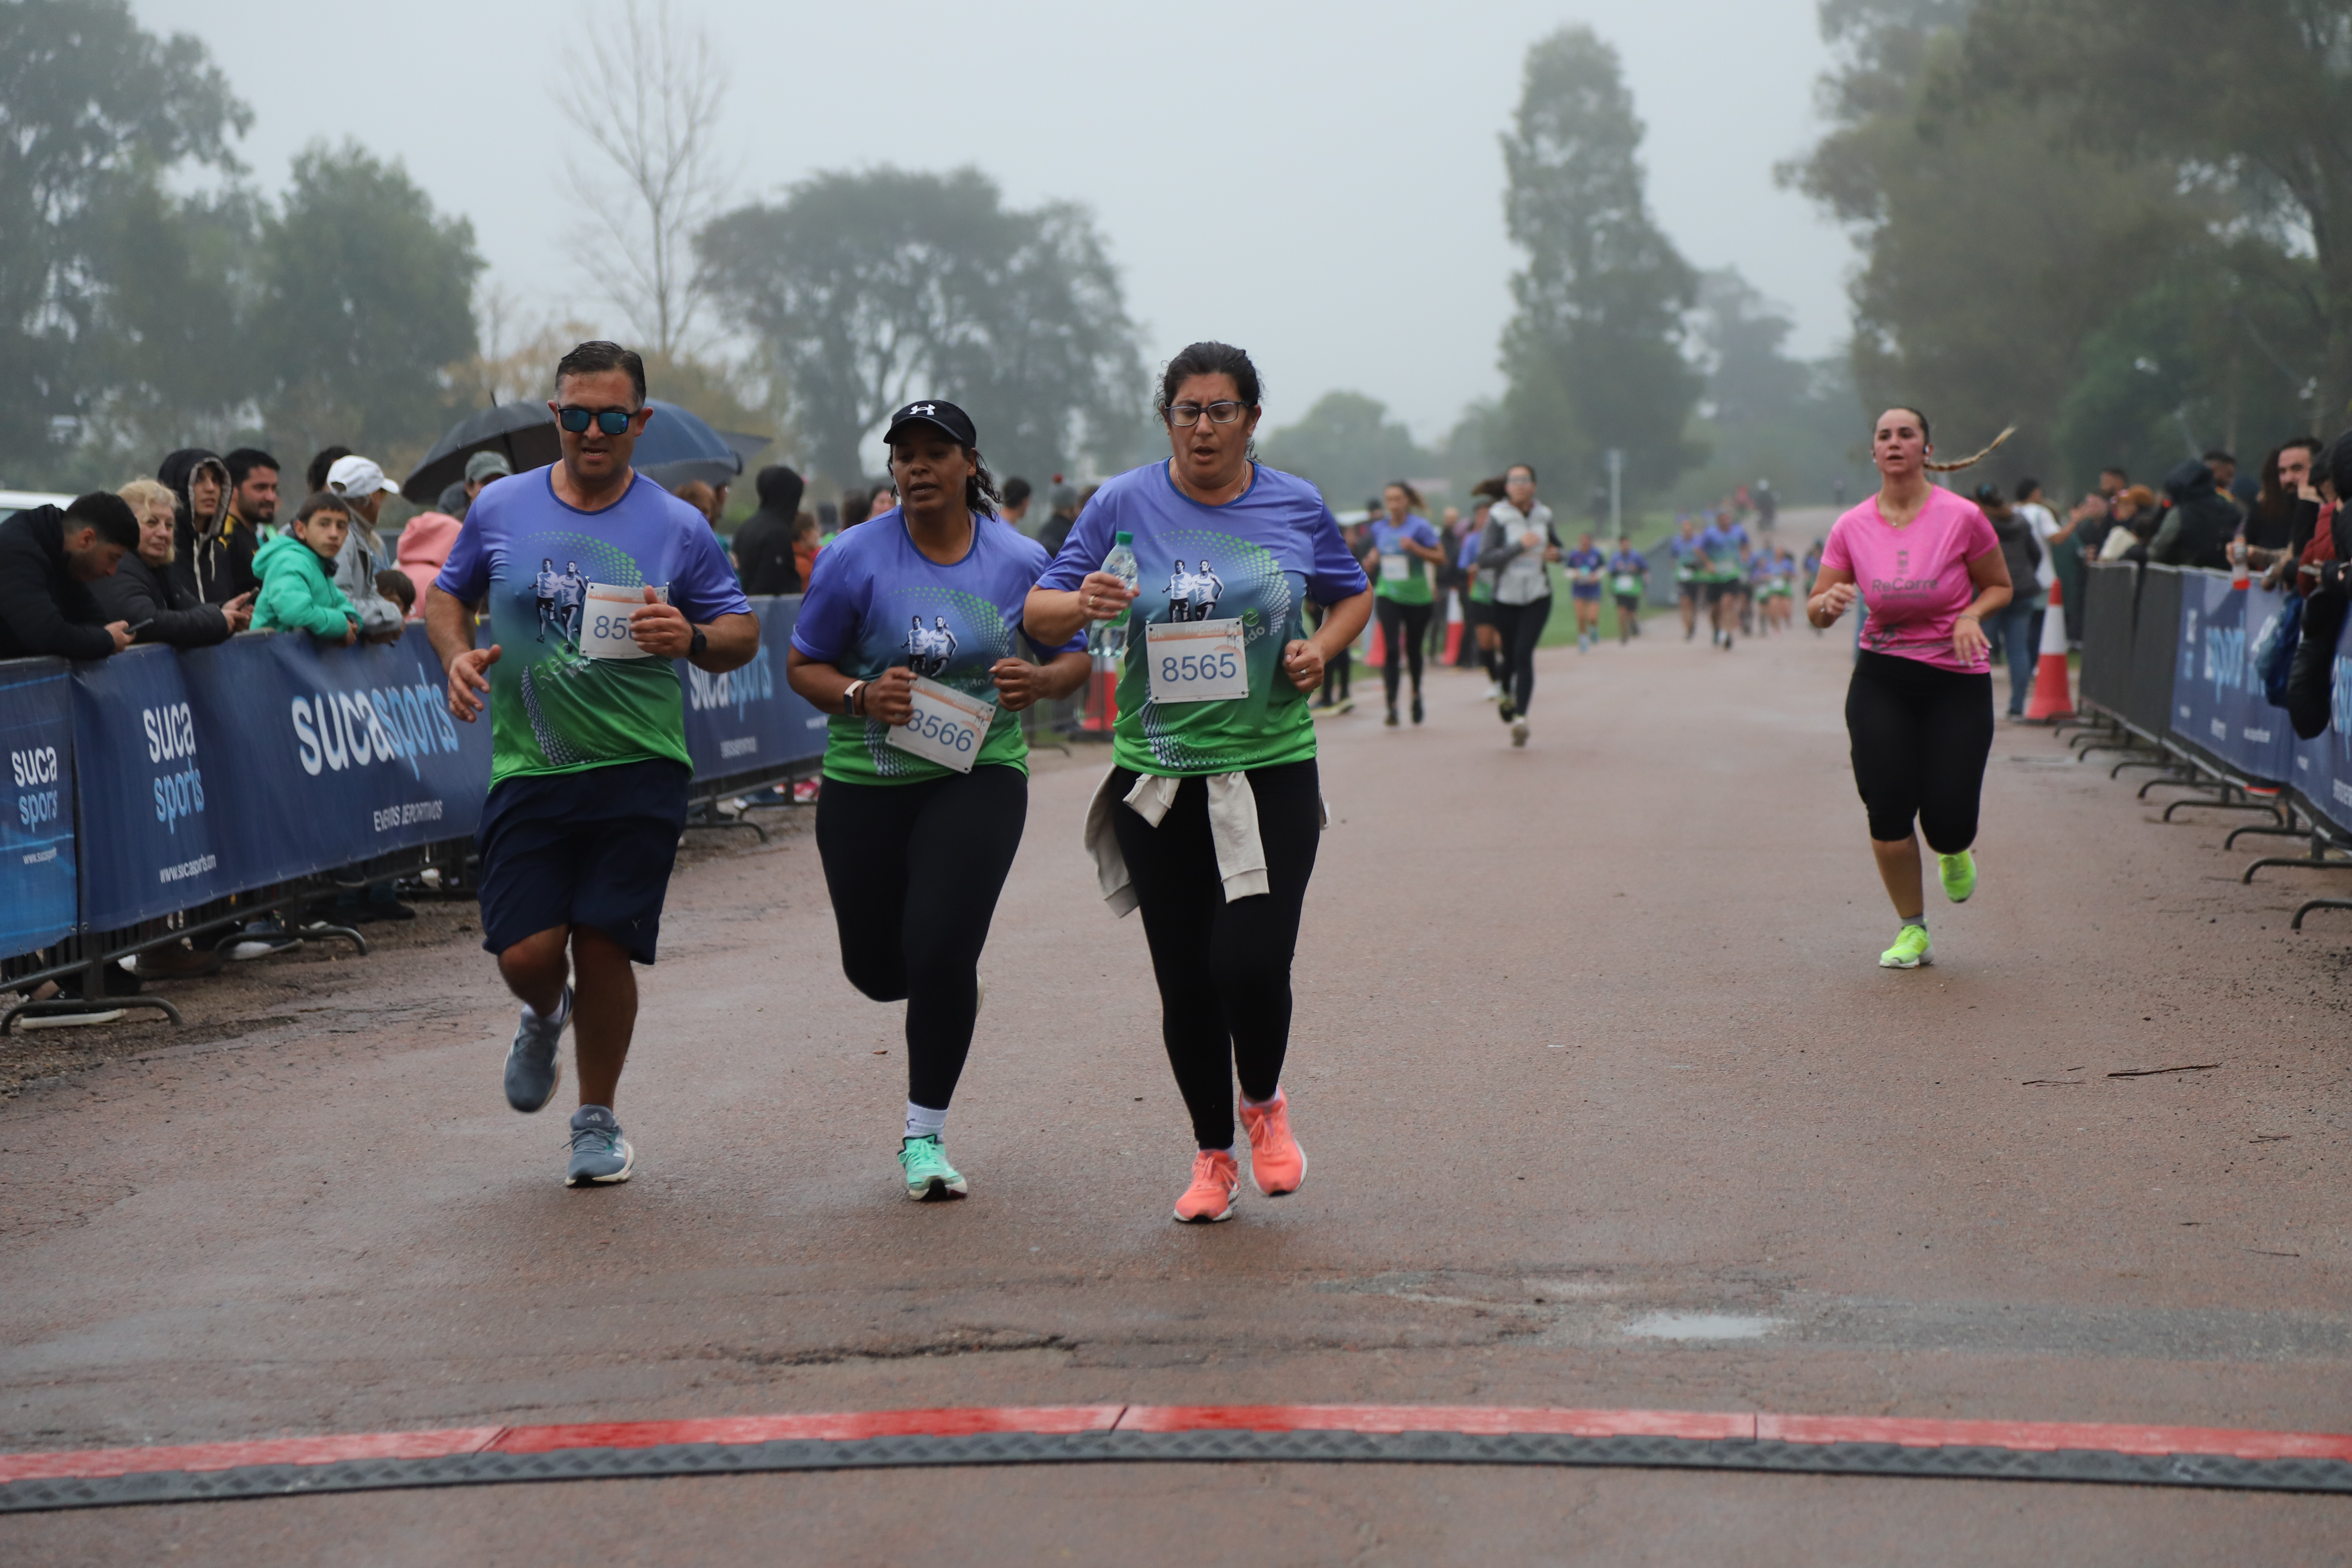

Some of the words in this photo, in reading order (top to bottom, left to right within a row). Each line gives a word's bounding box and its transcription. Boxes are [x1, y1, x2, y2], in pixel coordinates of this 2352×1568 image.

[1872, 577, 1938, 593] ReCorre
[594, 615, 638, 640] 85
[1162, 653, 1237, 682] 8565
[143, 702, 196, 764] suca
[291, 662, 459, 782] sucasports
[906, 709, 974, 752] 8566
[12, 746, 57, 787] suca
[154, 756, 205, 835] sports
